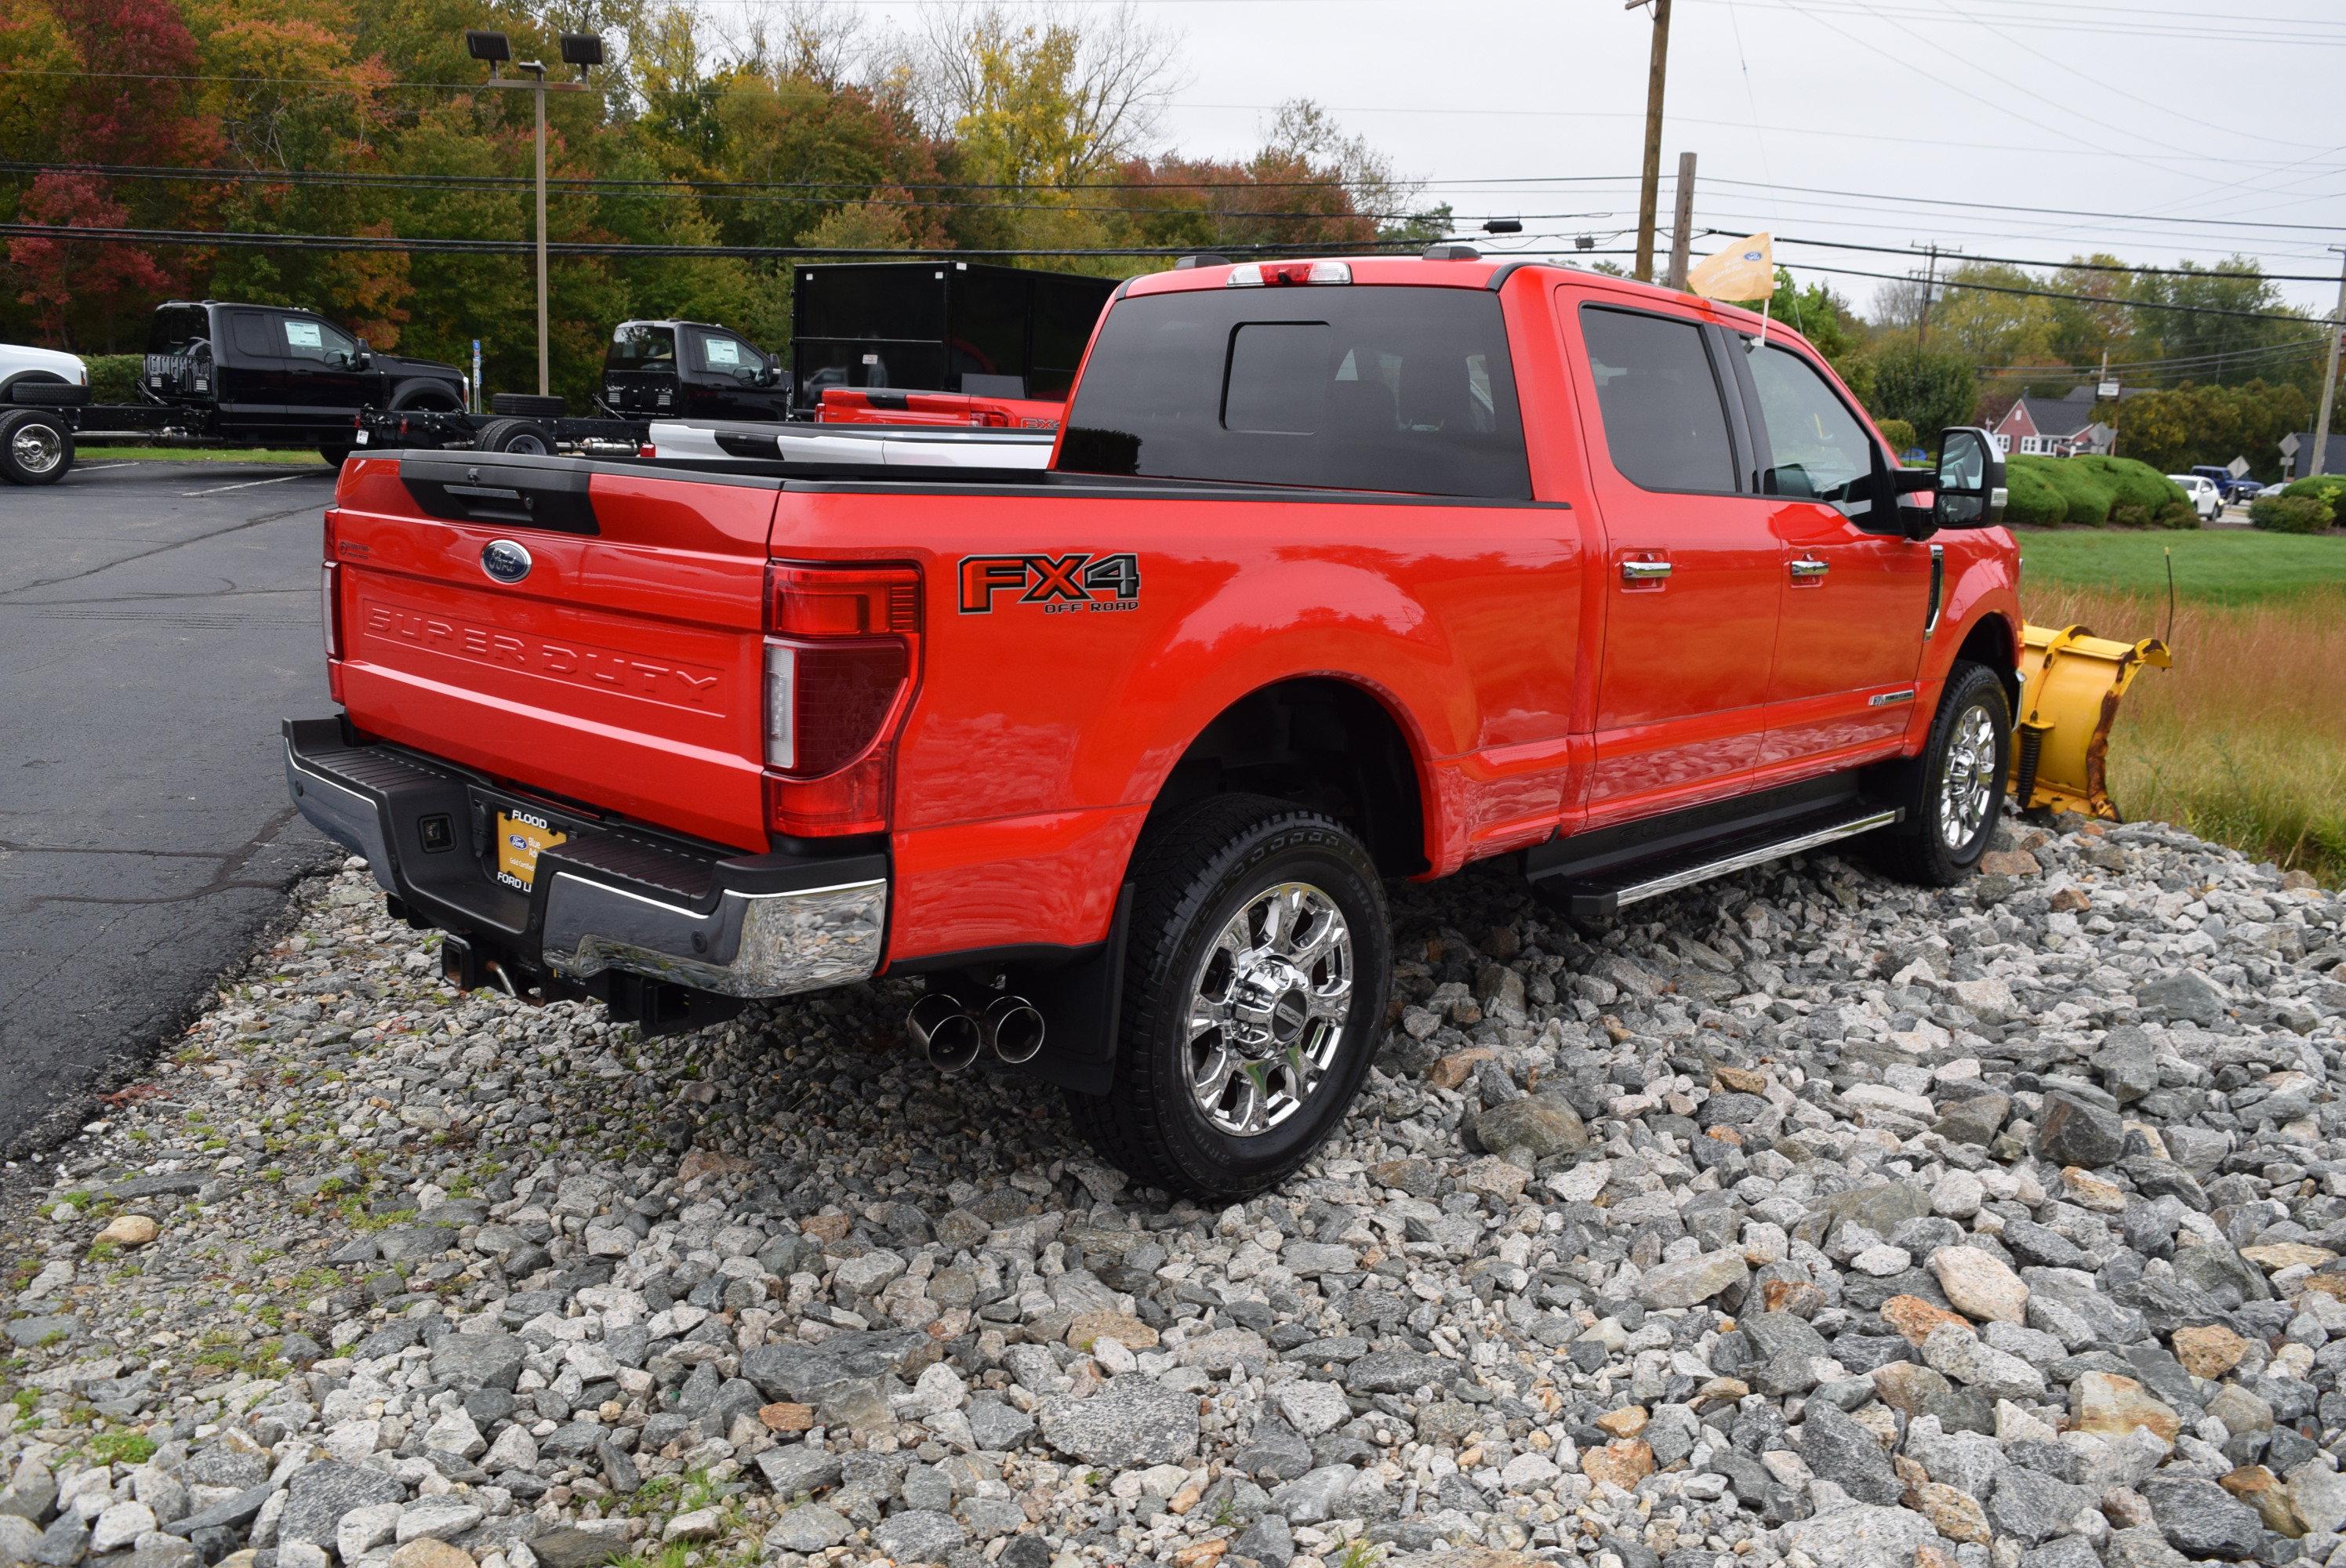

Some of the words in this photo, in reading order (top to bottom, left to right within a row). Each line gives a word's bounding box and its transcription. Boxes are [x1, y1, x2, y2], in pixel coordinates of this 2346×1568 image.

[488, 547, 517, 572] Ford
[957, 553, 1141, 615] FX4
[1044, 603, 1082, 614] OFF
[1090, 601, 1139, 612] ROAD
[369, 608, 525, 664] SUPER
[543, 644, 717, 702] DUTY
[512, 810, 547, 829] FLOOD
[528, 837, 540, 849] Blue
[497, 871, 521, 889] FORD
[1280, 1007, 1301, 1023] FORD
